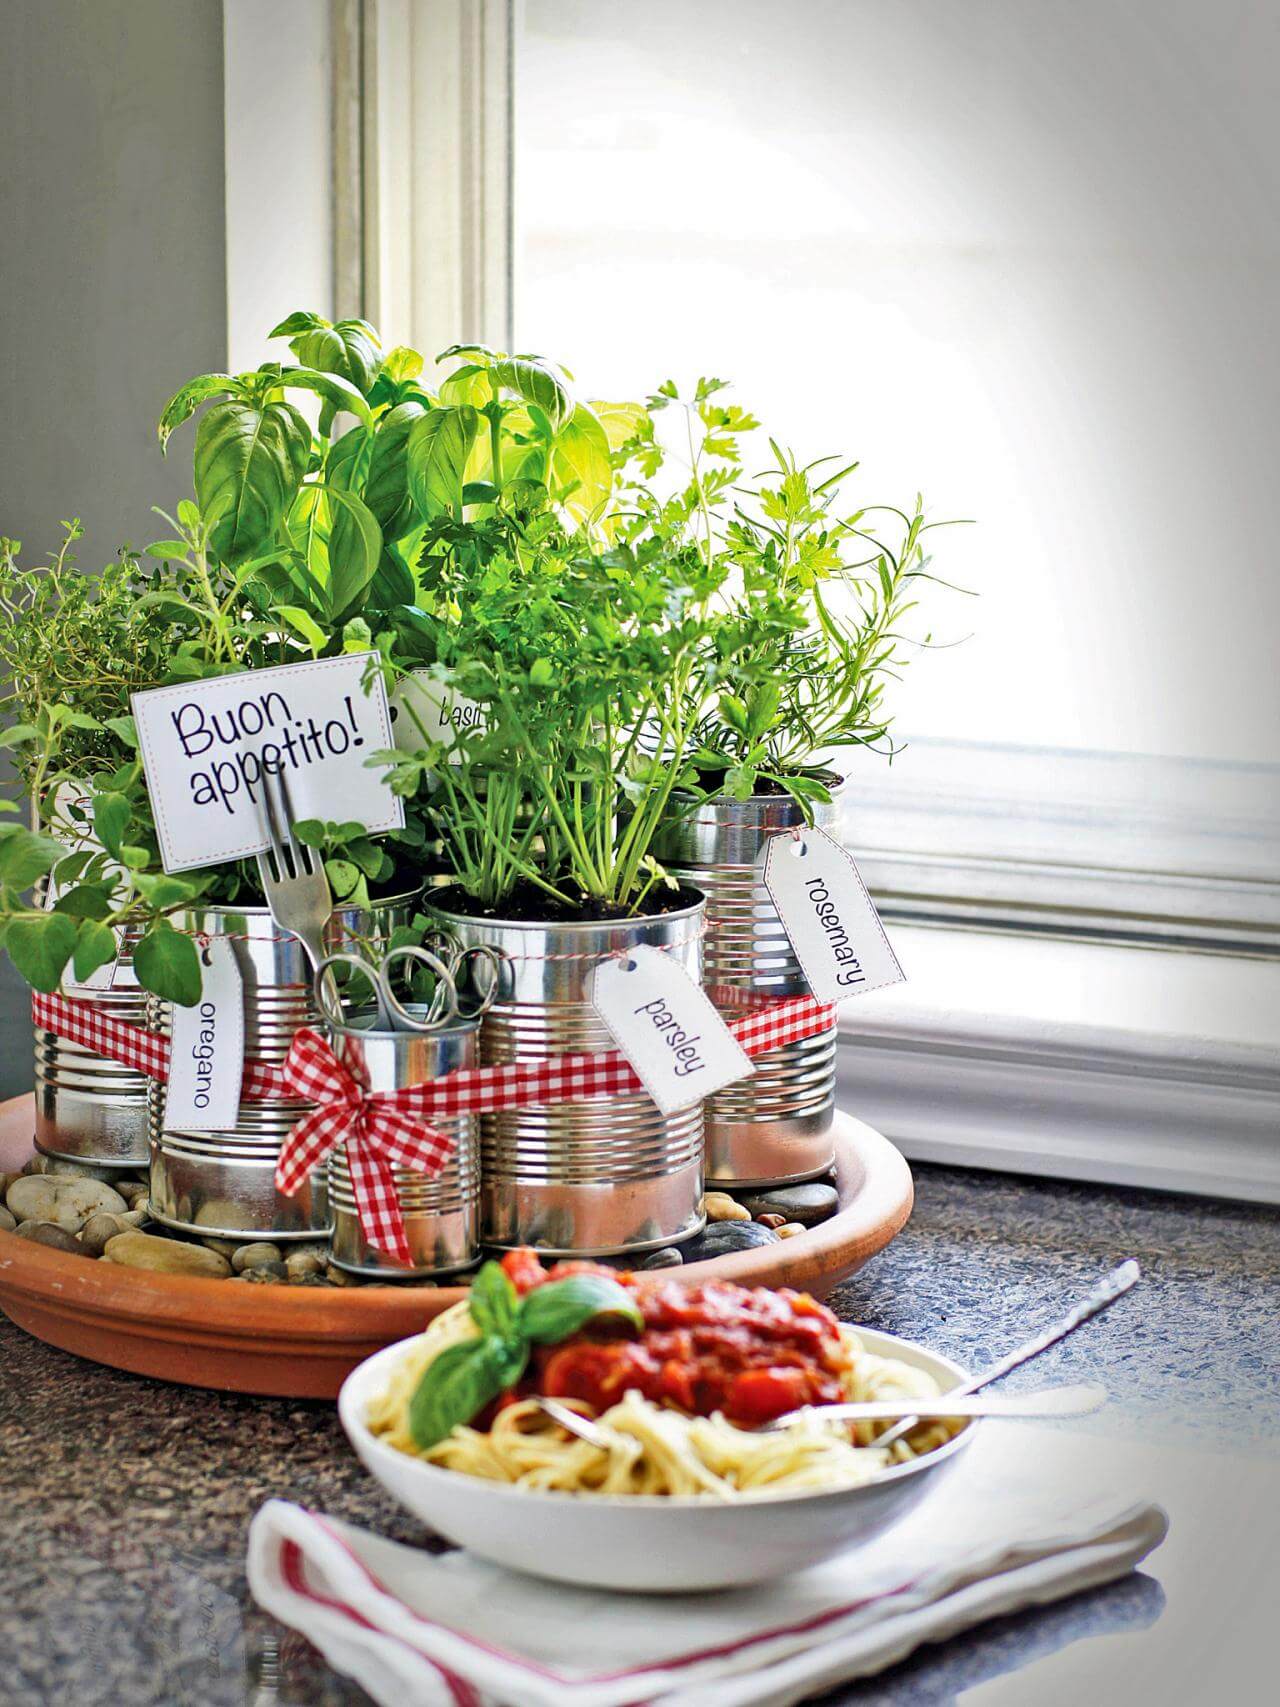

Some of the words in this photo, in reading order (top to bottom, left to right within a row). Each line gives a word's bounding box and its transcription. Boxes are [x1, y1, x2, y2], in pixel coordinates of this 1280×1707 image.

[171, 691, 292, 758] Buon
[190, 696, 364, 814] appetito!
[805, 877, 866, 986] rosemary
[192, 1002, 216, 1109] oregano
[634, 998, 706, 1077] parsley
